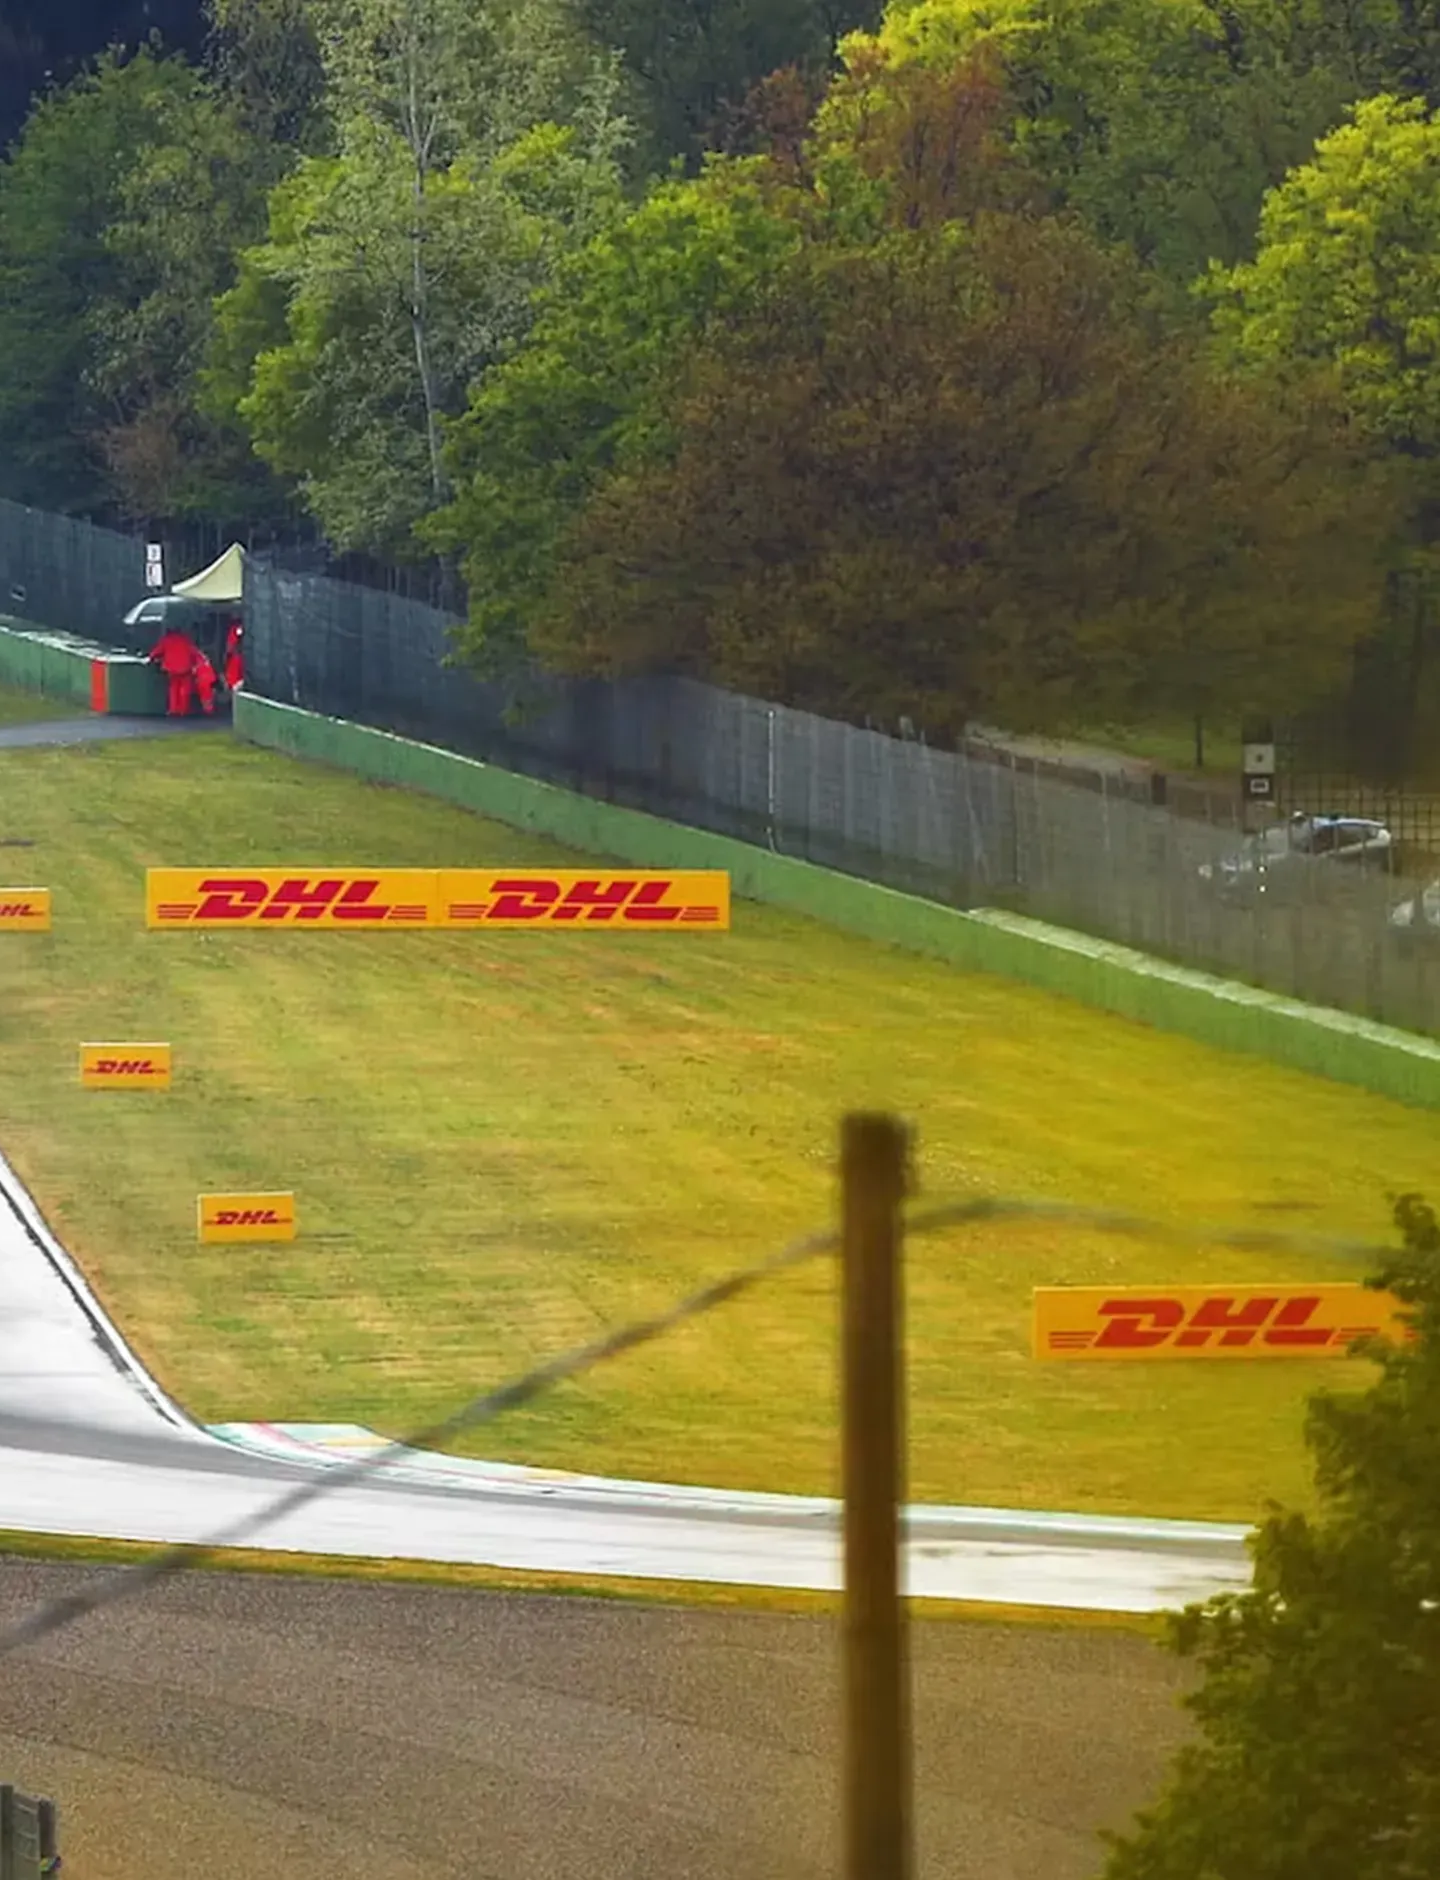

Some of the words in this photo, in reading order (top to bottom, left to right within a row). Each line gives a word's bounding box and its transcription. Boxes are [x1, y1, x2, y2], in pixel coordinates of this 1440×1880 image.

[195, 880, 390, 919] DHL
[486, 880, 682, 921] DHL
[95, 1060, 154, 1075] DHL
[215, 1210, 279, 1226] DHL
[1094, 1297, 1334, 1348] DHL
